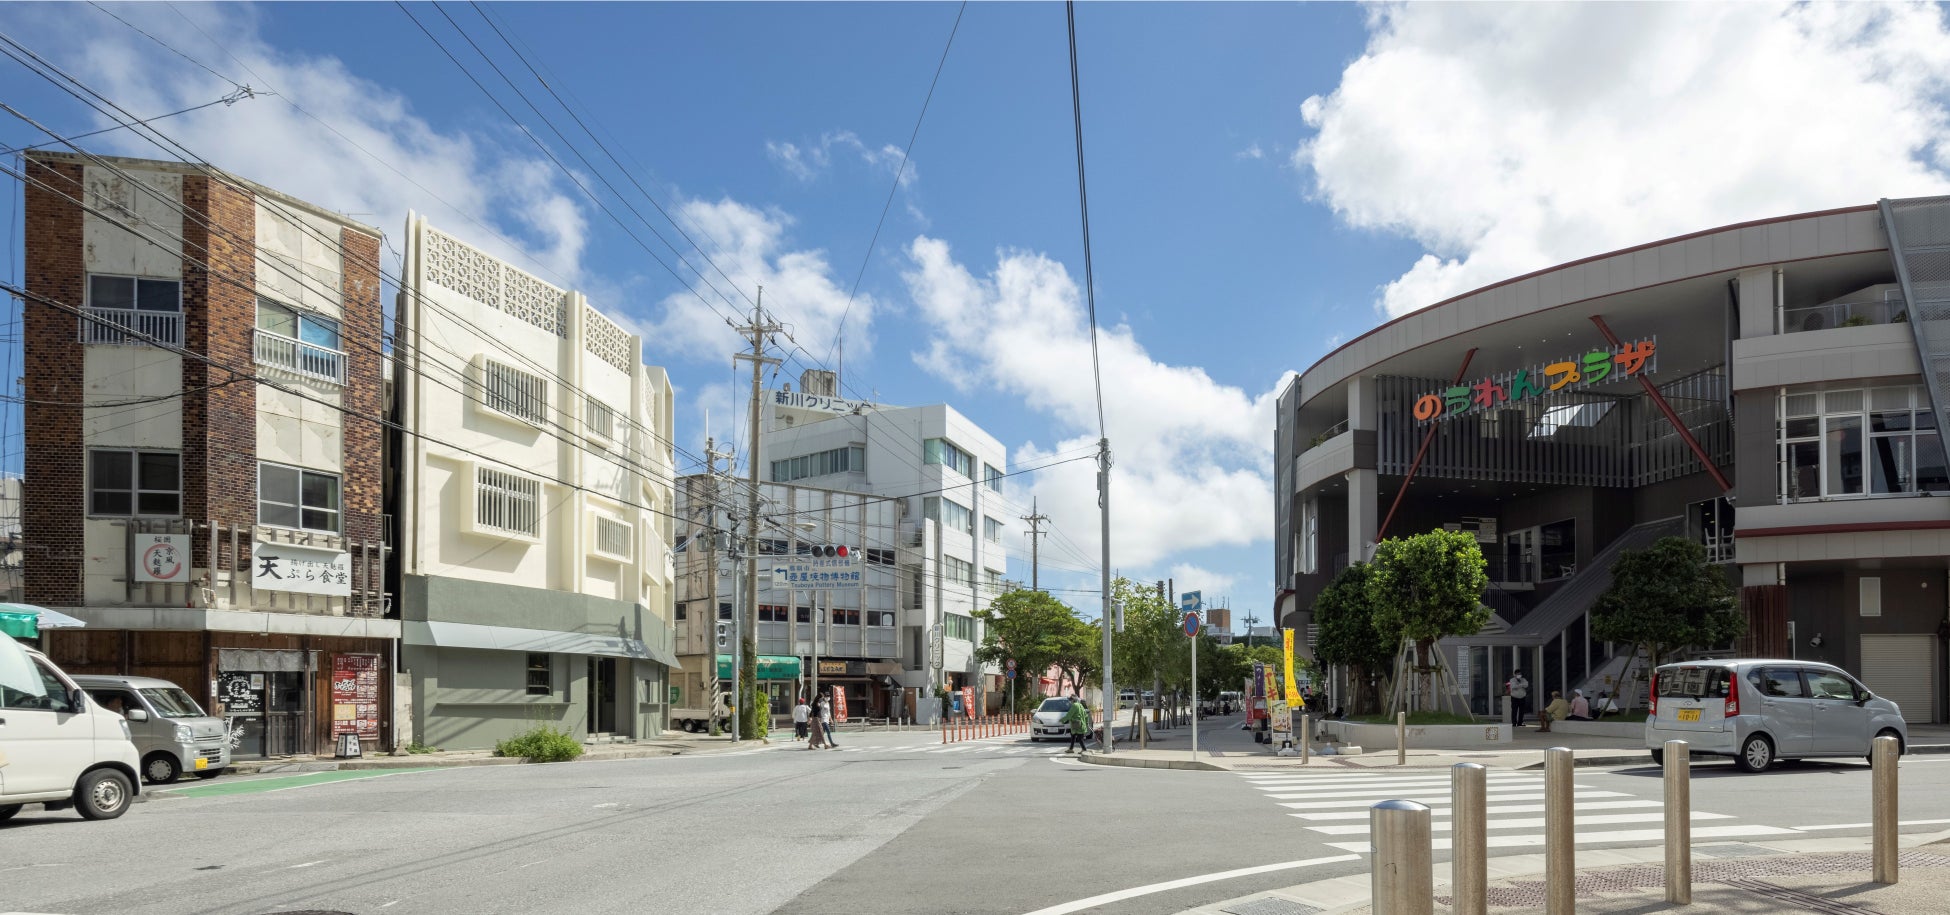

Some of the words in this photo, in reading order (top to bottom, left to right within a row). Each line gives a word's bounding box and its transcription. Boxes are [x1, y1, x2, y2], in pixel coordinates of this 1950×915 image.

[1413, 341, 1656, 420] のうれんプラザ
